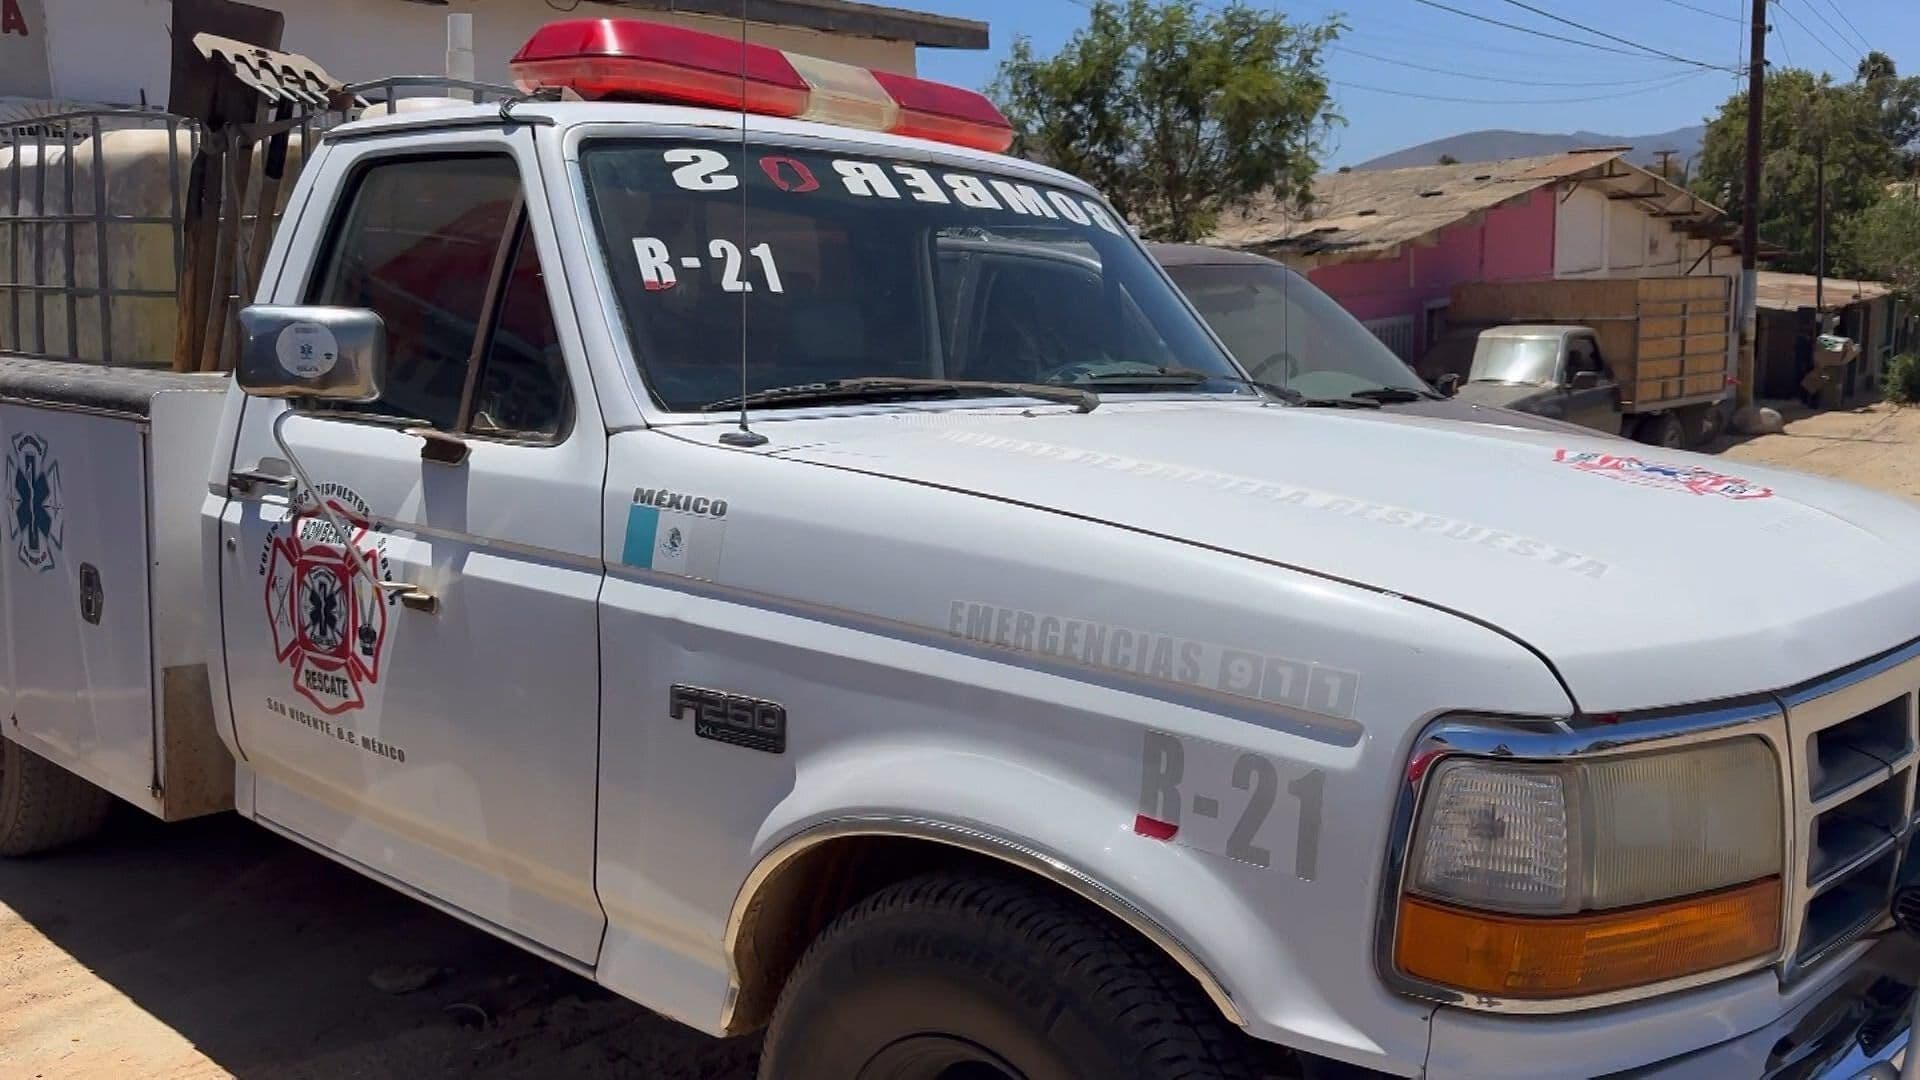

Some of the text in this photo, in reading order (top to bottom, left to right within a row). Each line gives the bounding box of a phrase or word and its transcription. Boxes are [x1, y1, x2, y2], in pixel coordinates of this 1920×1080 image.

[631, 237, 783, 293] R-21
[633, 487, 728, 517] MÉXICO
[1321, 496, 1609, 579] RESPUESTA
[304, 669, 349, 698] RESCATE
[948, 601, 1349, 711] EMERGENCIAS 911
[267, 697, 287, 716] SAN
[1134, 728, 1328, 882] R-21
